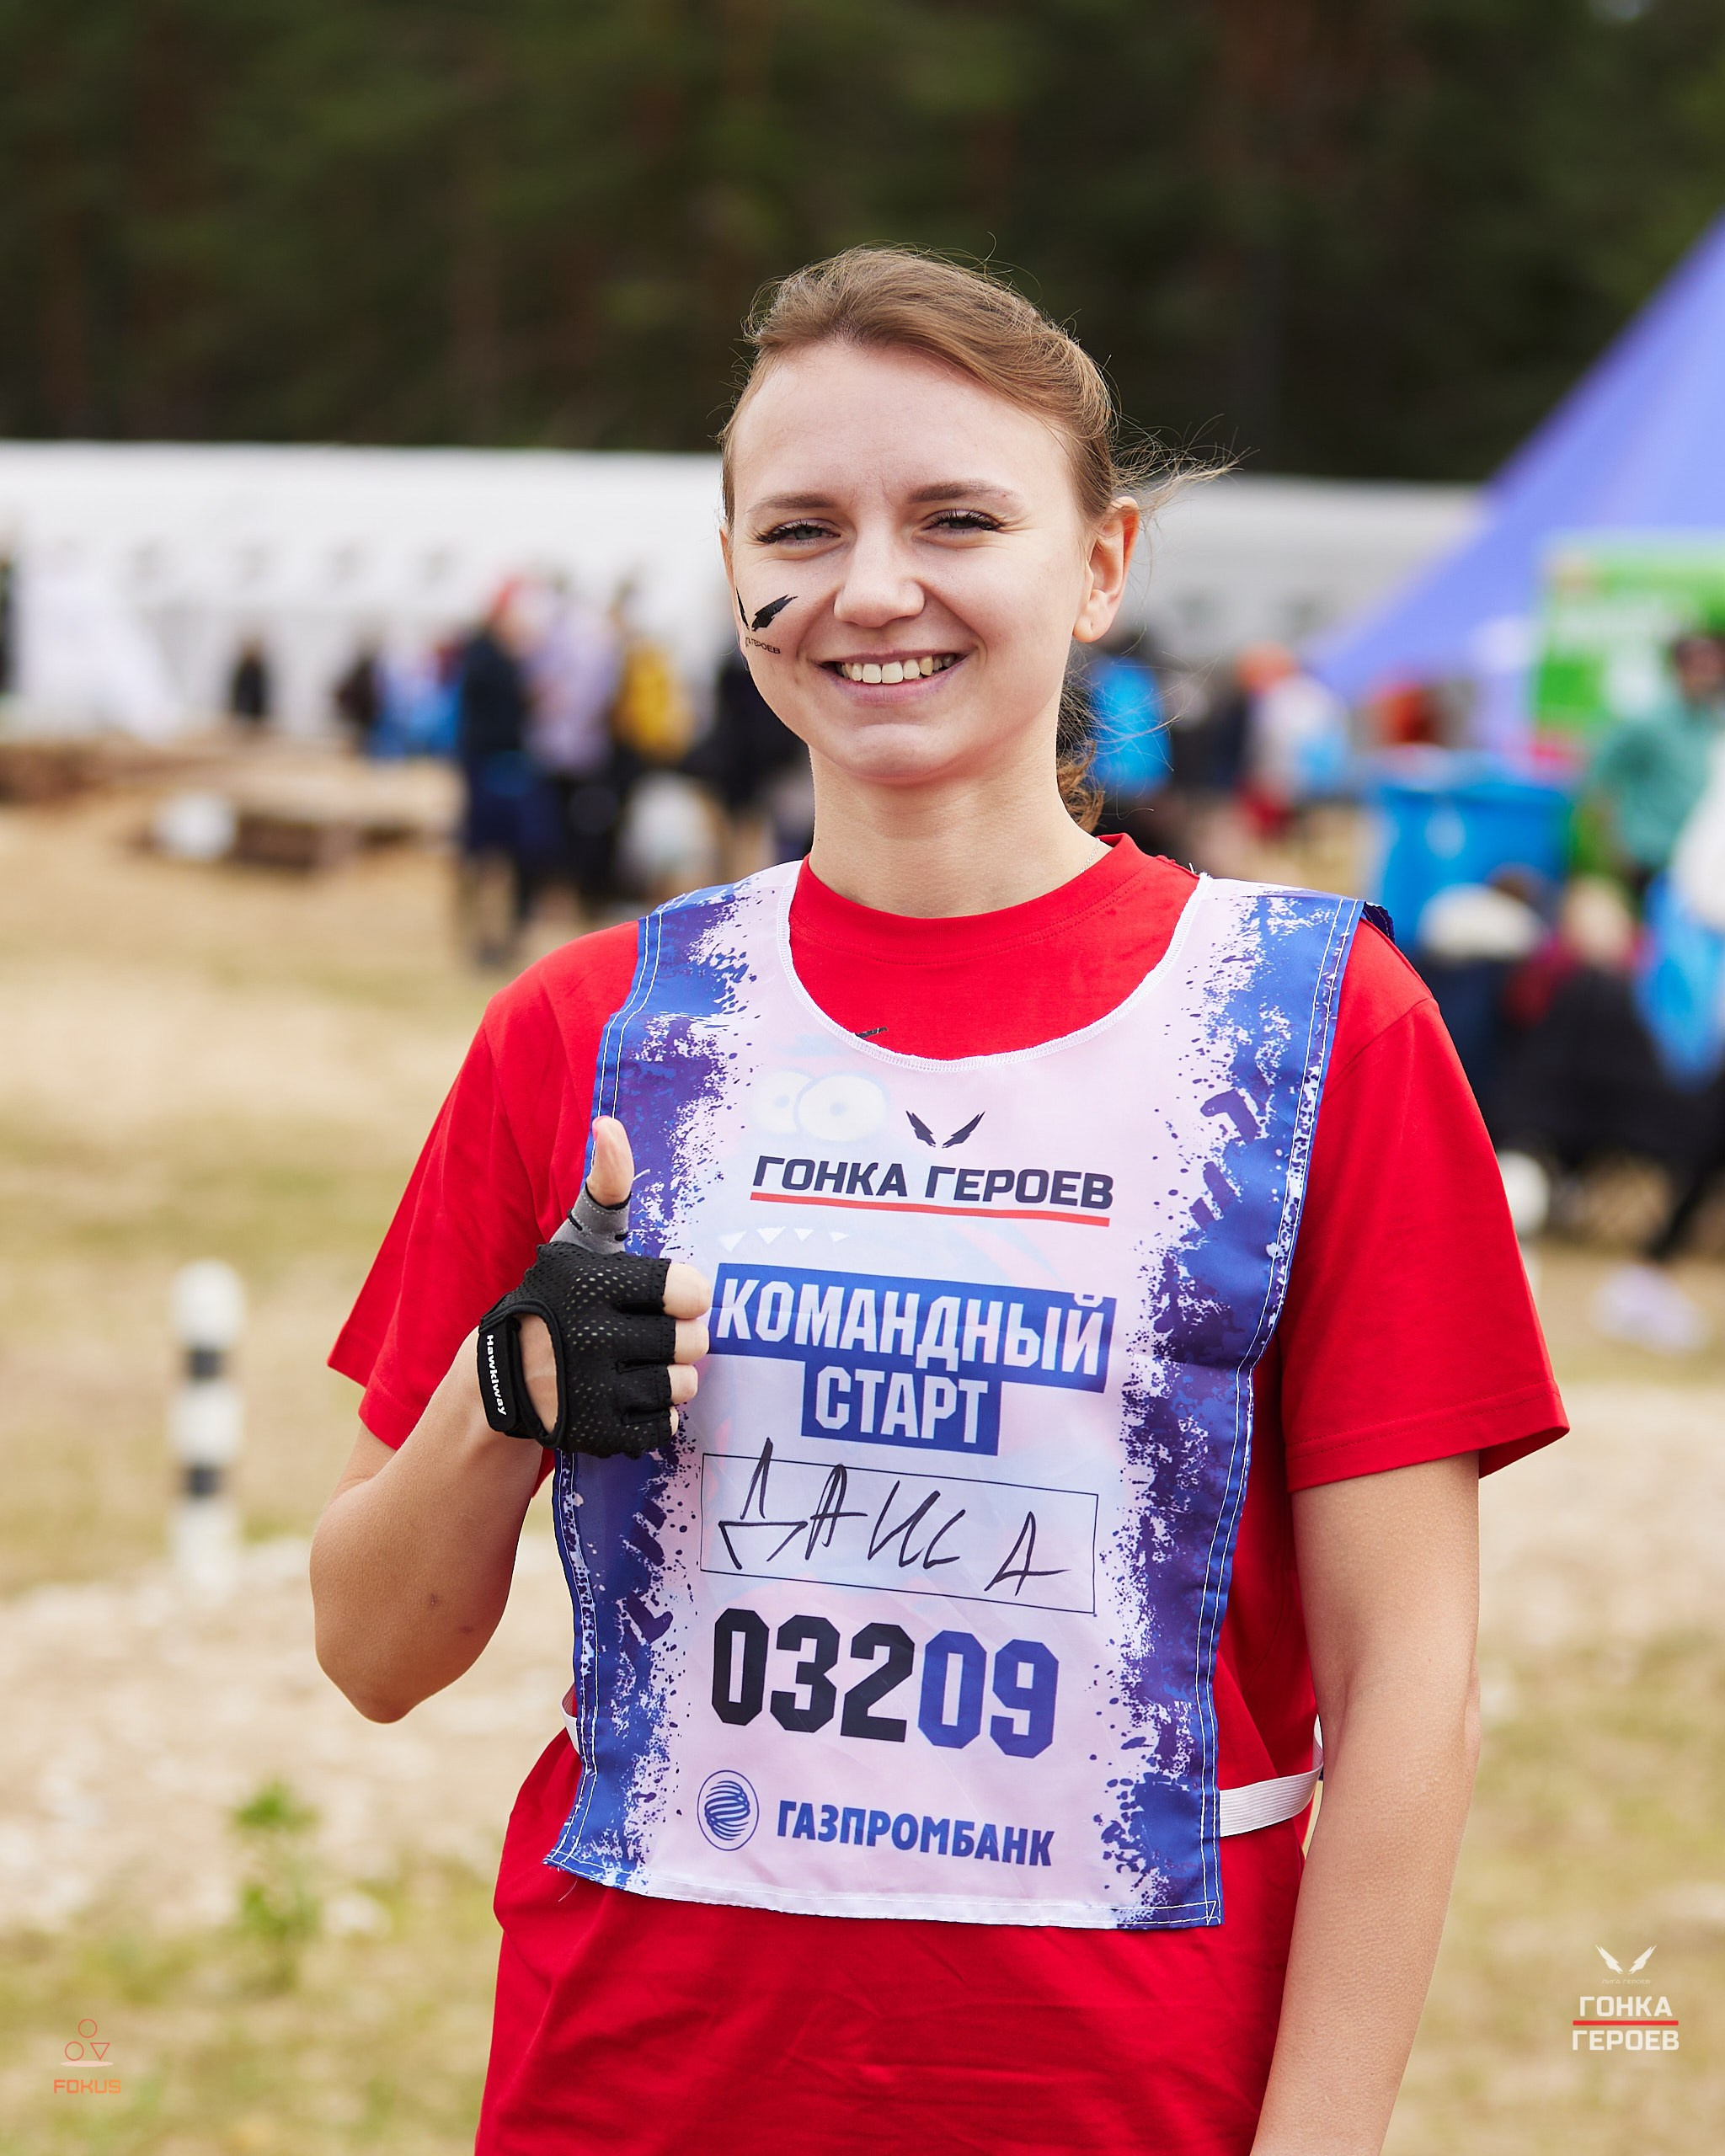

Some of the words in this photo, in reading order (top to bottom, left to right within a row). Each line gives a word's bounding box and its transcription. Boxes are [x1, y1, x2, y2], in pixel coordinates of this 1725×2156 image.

[751, 1155, 908, 1197] ГОНКА
[925, 1166, 1114, 1210] ГЕРОЕВ
[716, 1278, 1104, 1375] КОМАНДНЫЙ
[814, 1365, 988, 1444] СТАРТ
[711, 1608, 1060, 1758] 03209
[777, 1800, 1055, 1866] ГАЗПРОМБАНК
